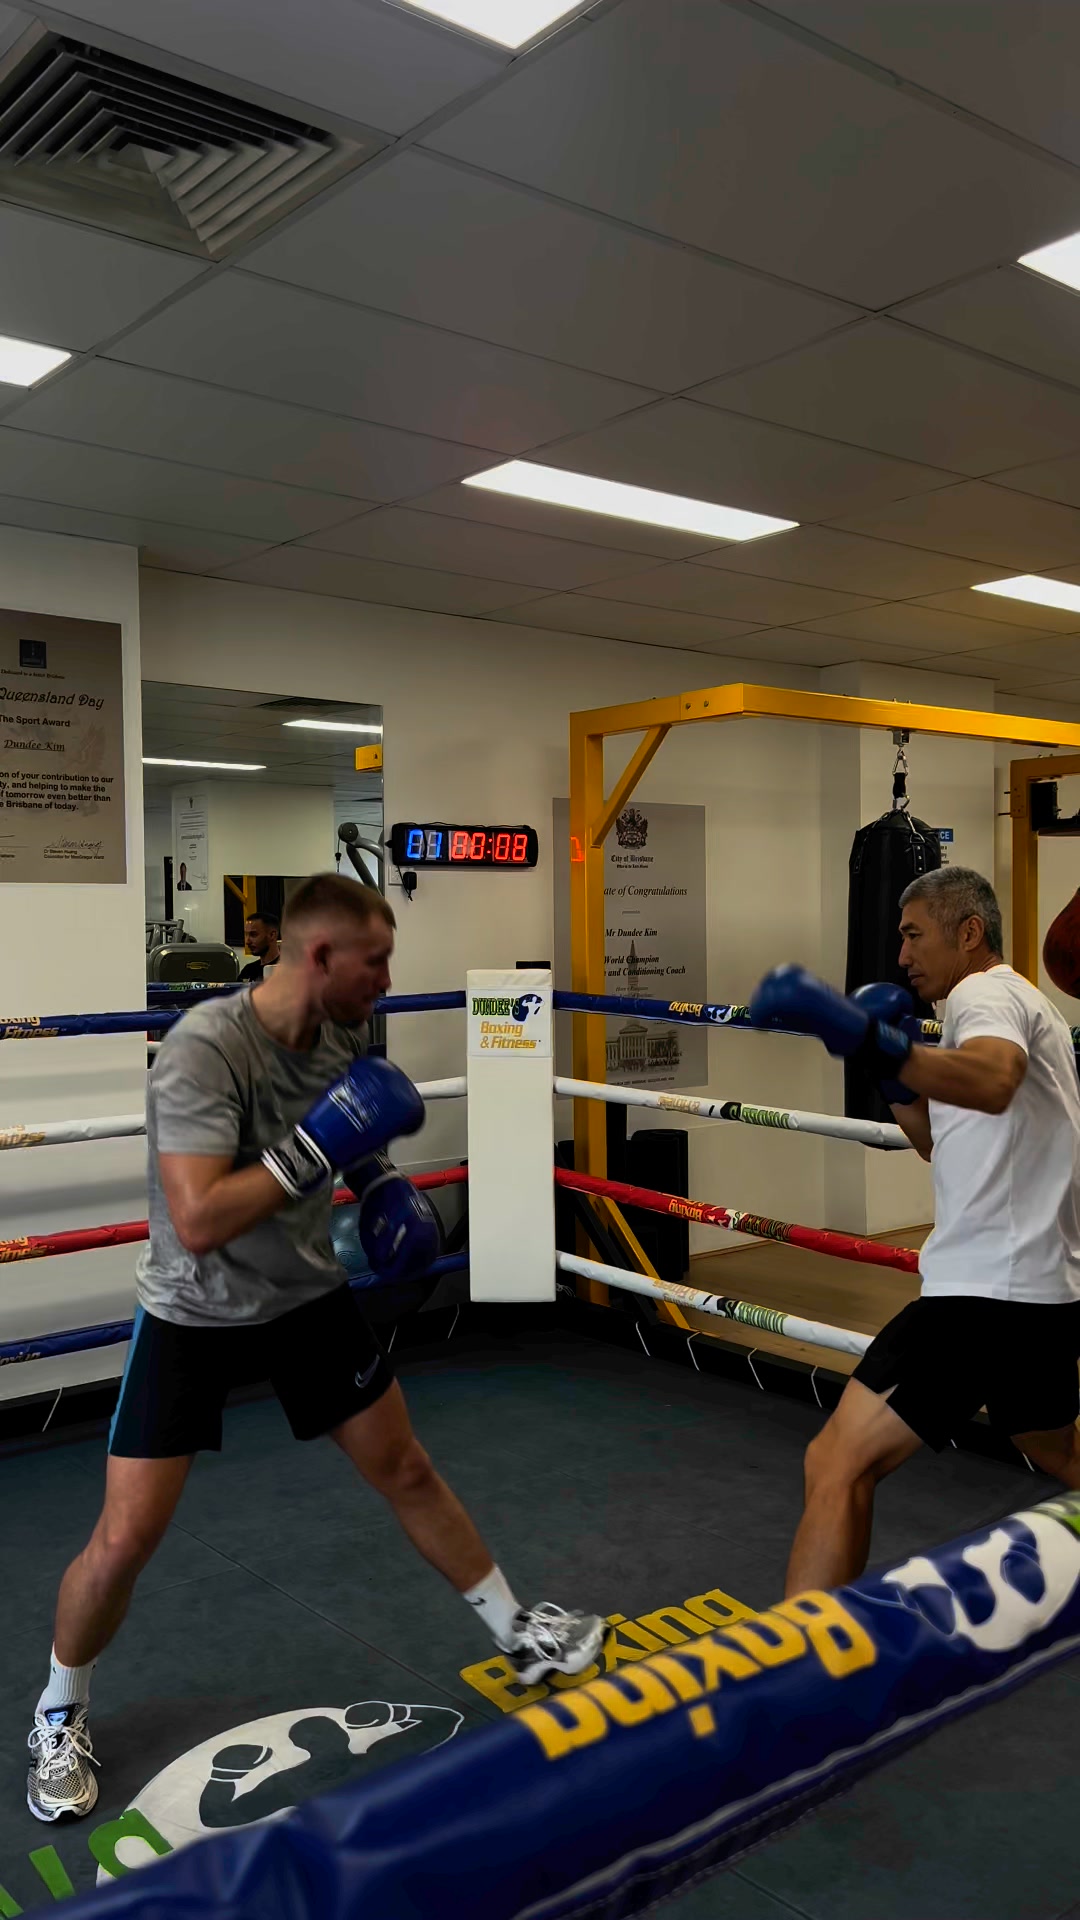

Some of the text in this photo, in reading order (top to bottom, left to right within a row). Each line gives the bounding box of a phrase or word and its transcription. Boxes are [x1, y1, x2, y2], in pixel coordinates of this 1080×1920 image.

[0, 687, 104, 710] Queensland Day
[16, 715, 40, 726] Sport
[42, 717, 71, 727] Award
[4, 739, 65, 752] Dundee Kim
[11, 771, 20, 779] of
[21, 772, 40, 780] your
[41, 773, 90, 782] contribution
[92, 775, 99, 783] to
[11, 781, 27, 789] and
[29, 782, 59, 791] helping
[70, 784, 91, 792] make
[6, 790, 45, 799] tomorrow
[47, 792, 66, 800] even
[68, 792, 92, 801] better
[94, 794, 111, 802] than
[6, 800, 43, 809] Brisbane
[55, 802, 79, 812] today.
[618, 885, 627, 898] of
[628, 885, 688, 899] Congratulations
[605, 928, 658, 937] Mr Dundee Kim
[627, 955, 660, 966] Champion
[608, 966, 686, 977] and Conditioning Coach
[480, 1021, 523, 1037] Boxing
[480, 1036, 538, 1049] & Fitness
